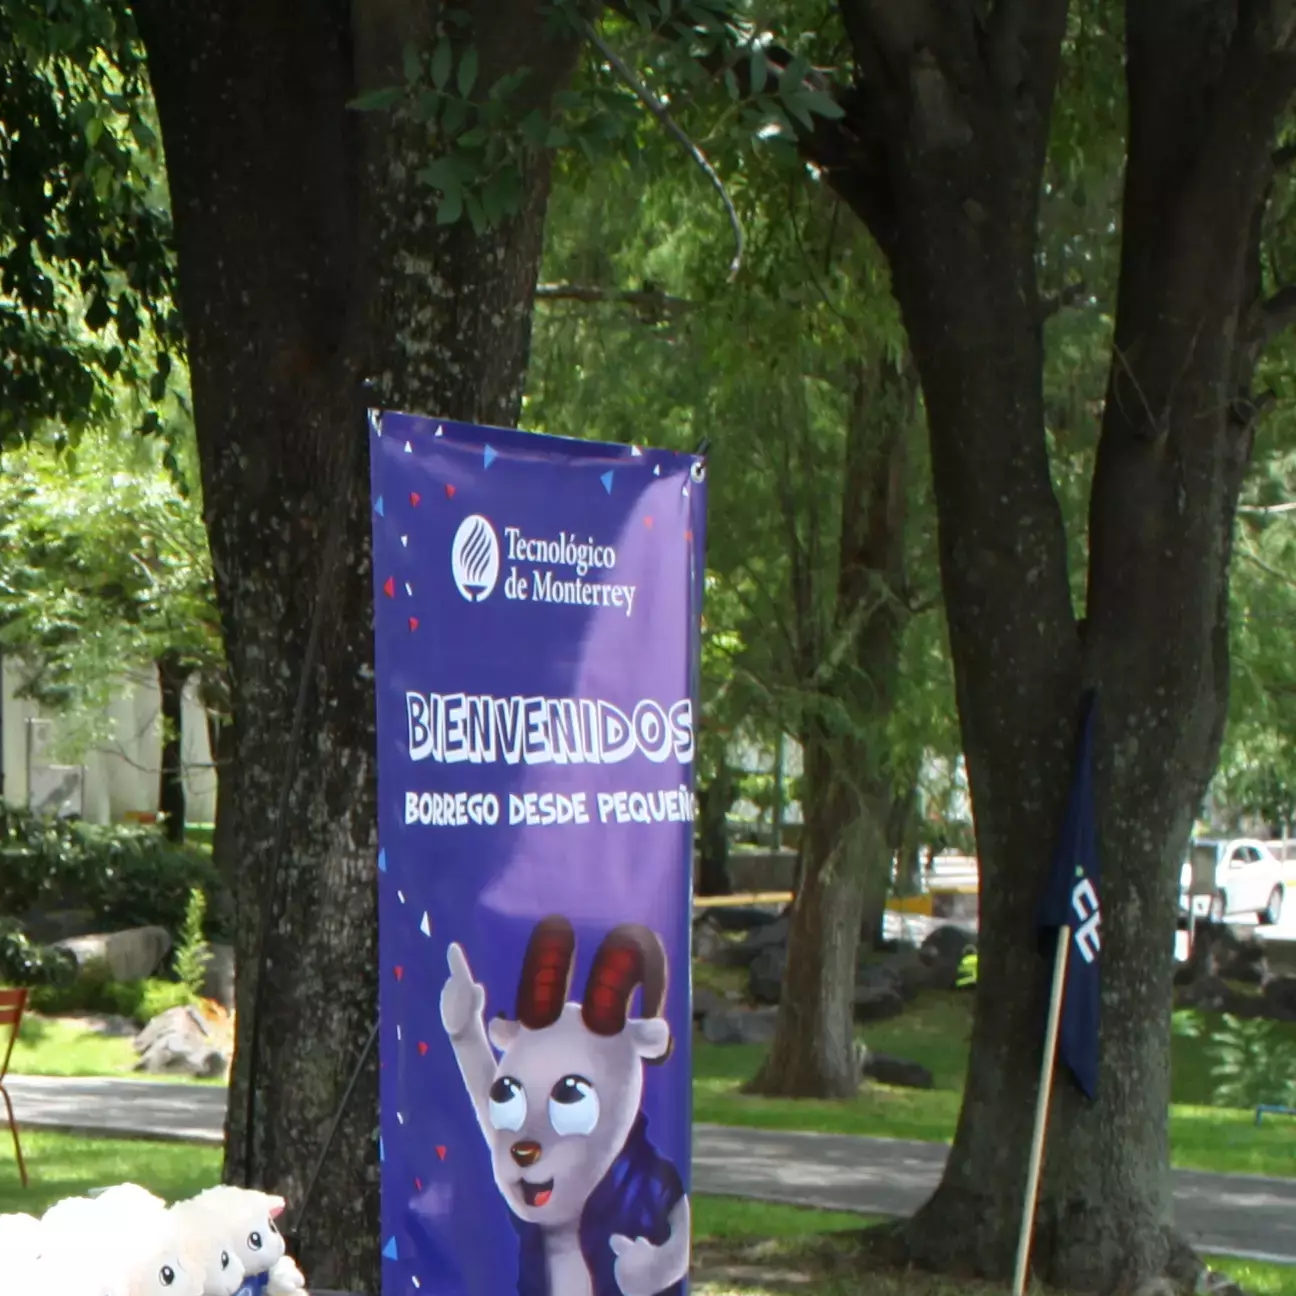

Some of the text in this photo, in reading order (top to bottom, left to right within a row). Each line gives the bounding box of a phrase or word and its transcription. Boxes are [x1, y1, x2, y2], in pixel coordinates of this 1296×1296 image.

[504, 526, 616, 577] Tecnológico
[504, 566, 636, 617] de Monterrey
[406, 691, 694, 764] BIENVENIDOS
[404, 791, 500, 826] BORREGO
[508, 792, 590, 826] DESDE
